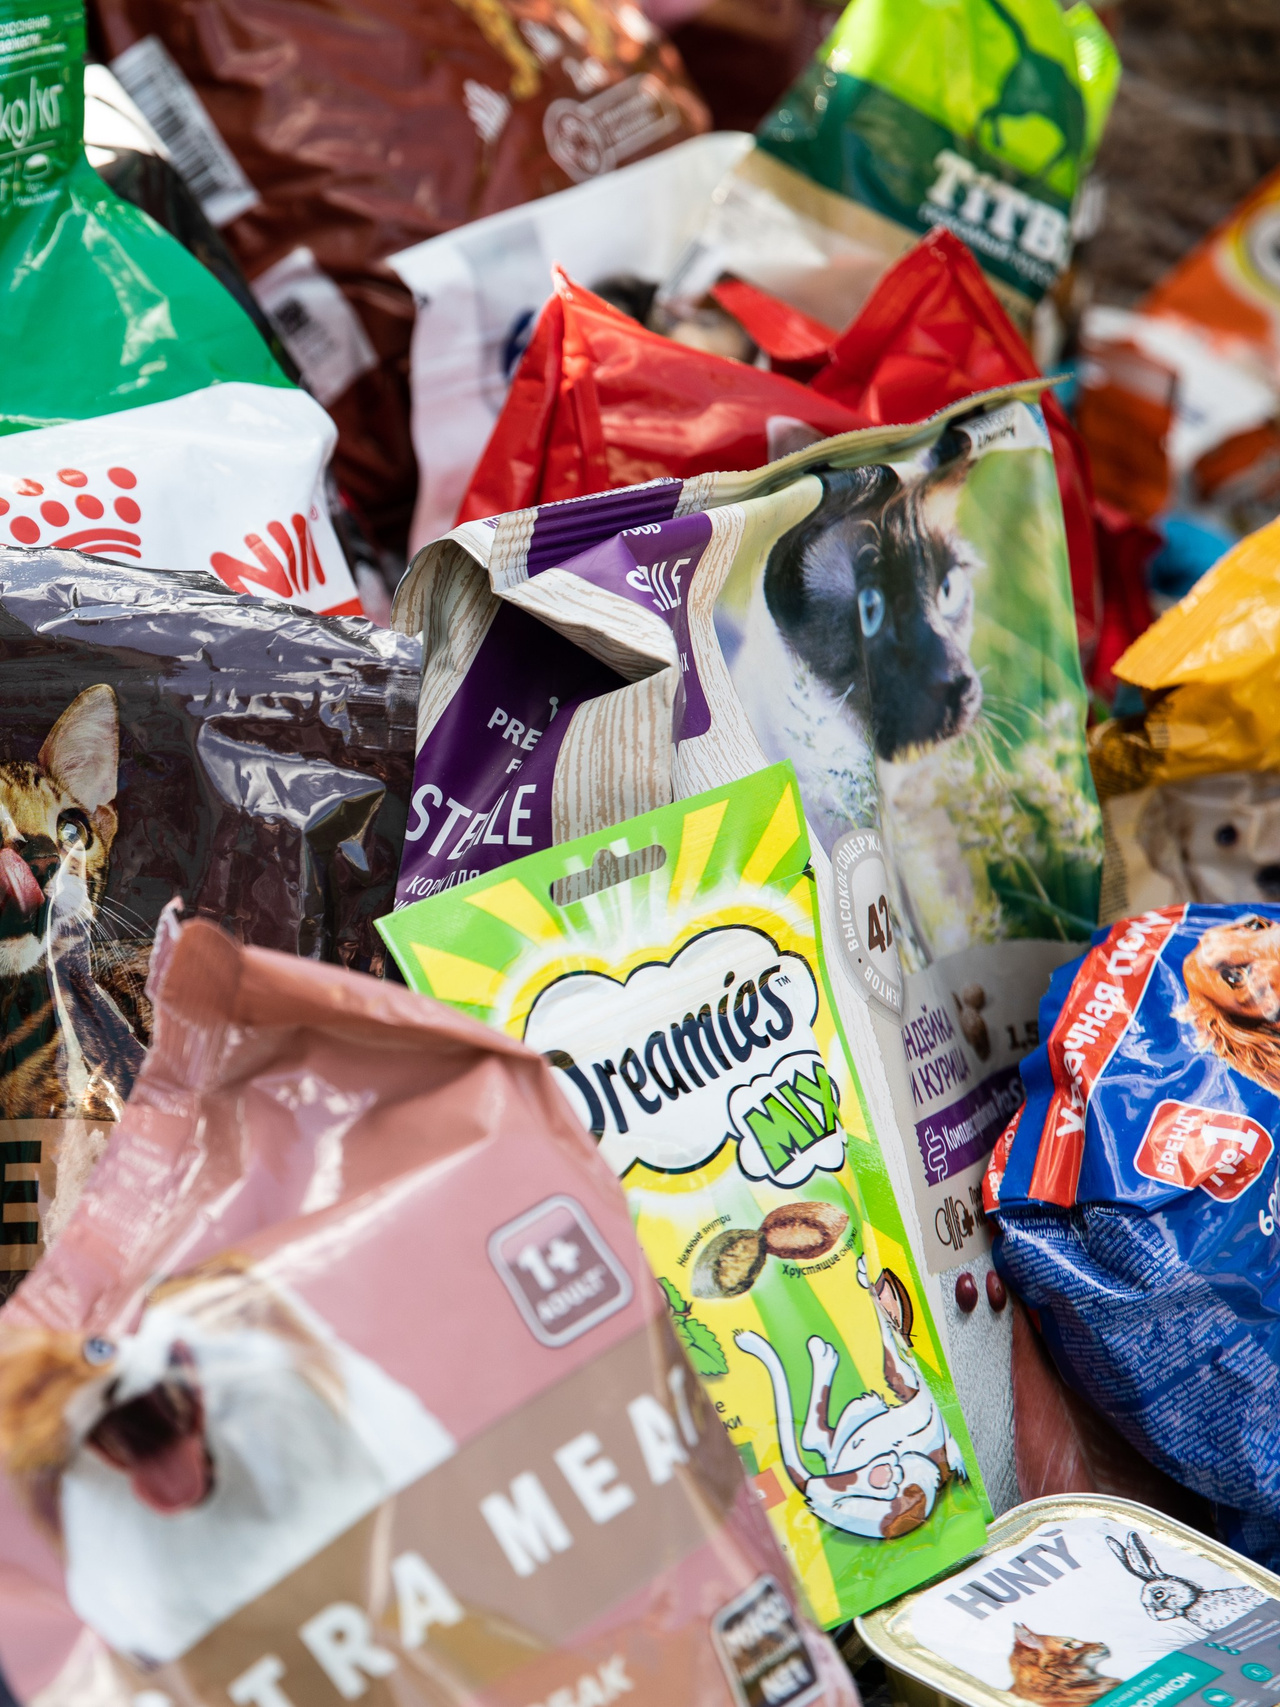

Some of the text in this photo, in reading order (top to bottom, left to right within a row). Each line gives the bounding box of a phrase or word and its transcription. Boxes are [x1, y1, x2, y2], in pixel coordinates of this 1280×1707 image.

[908, 1067, 921, 1107] И
[919, 1043, 973, 1101] КУРИЦА
[743, 1060, 846, 1177] MIX
[1155, 1111, 1199, 1177] БРЕНД
[517, 1237, 581, 1292] 1+
[677, 1230, 704, 1269] Нежные
[781, 1253, 841, 1279] Хрустящие
